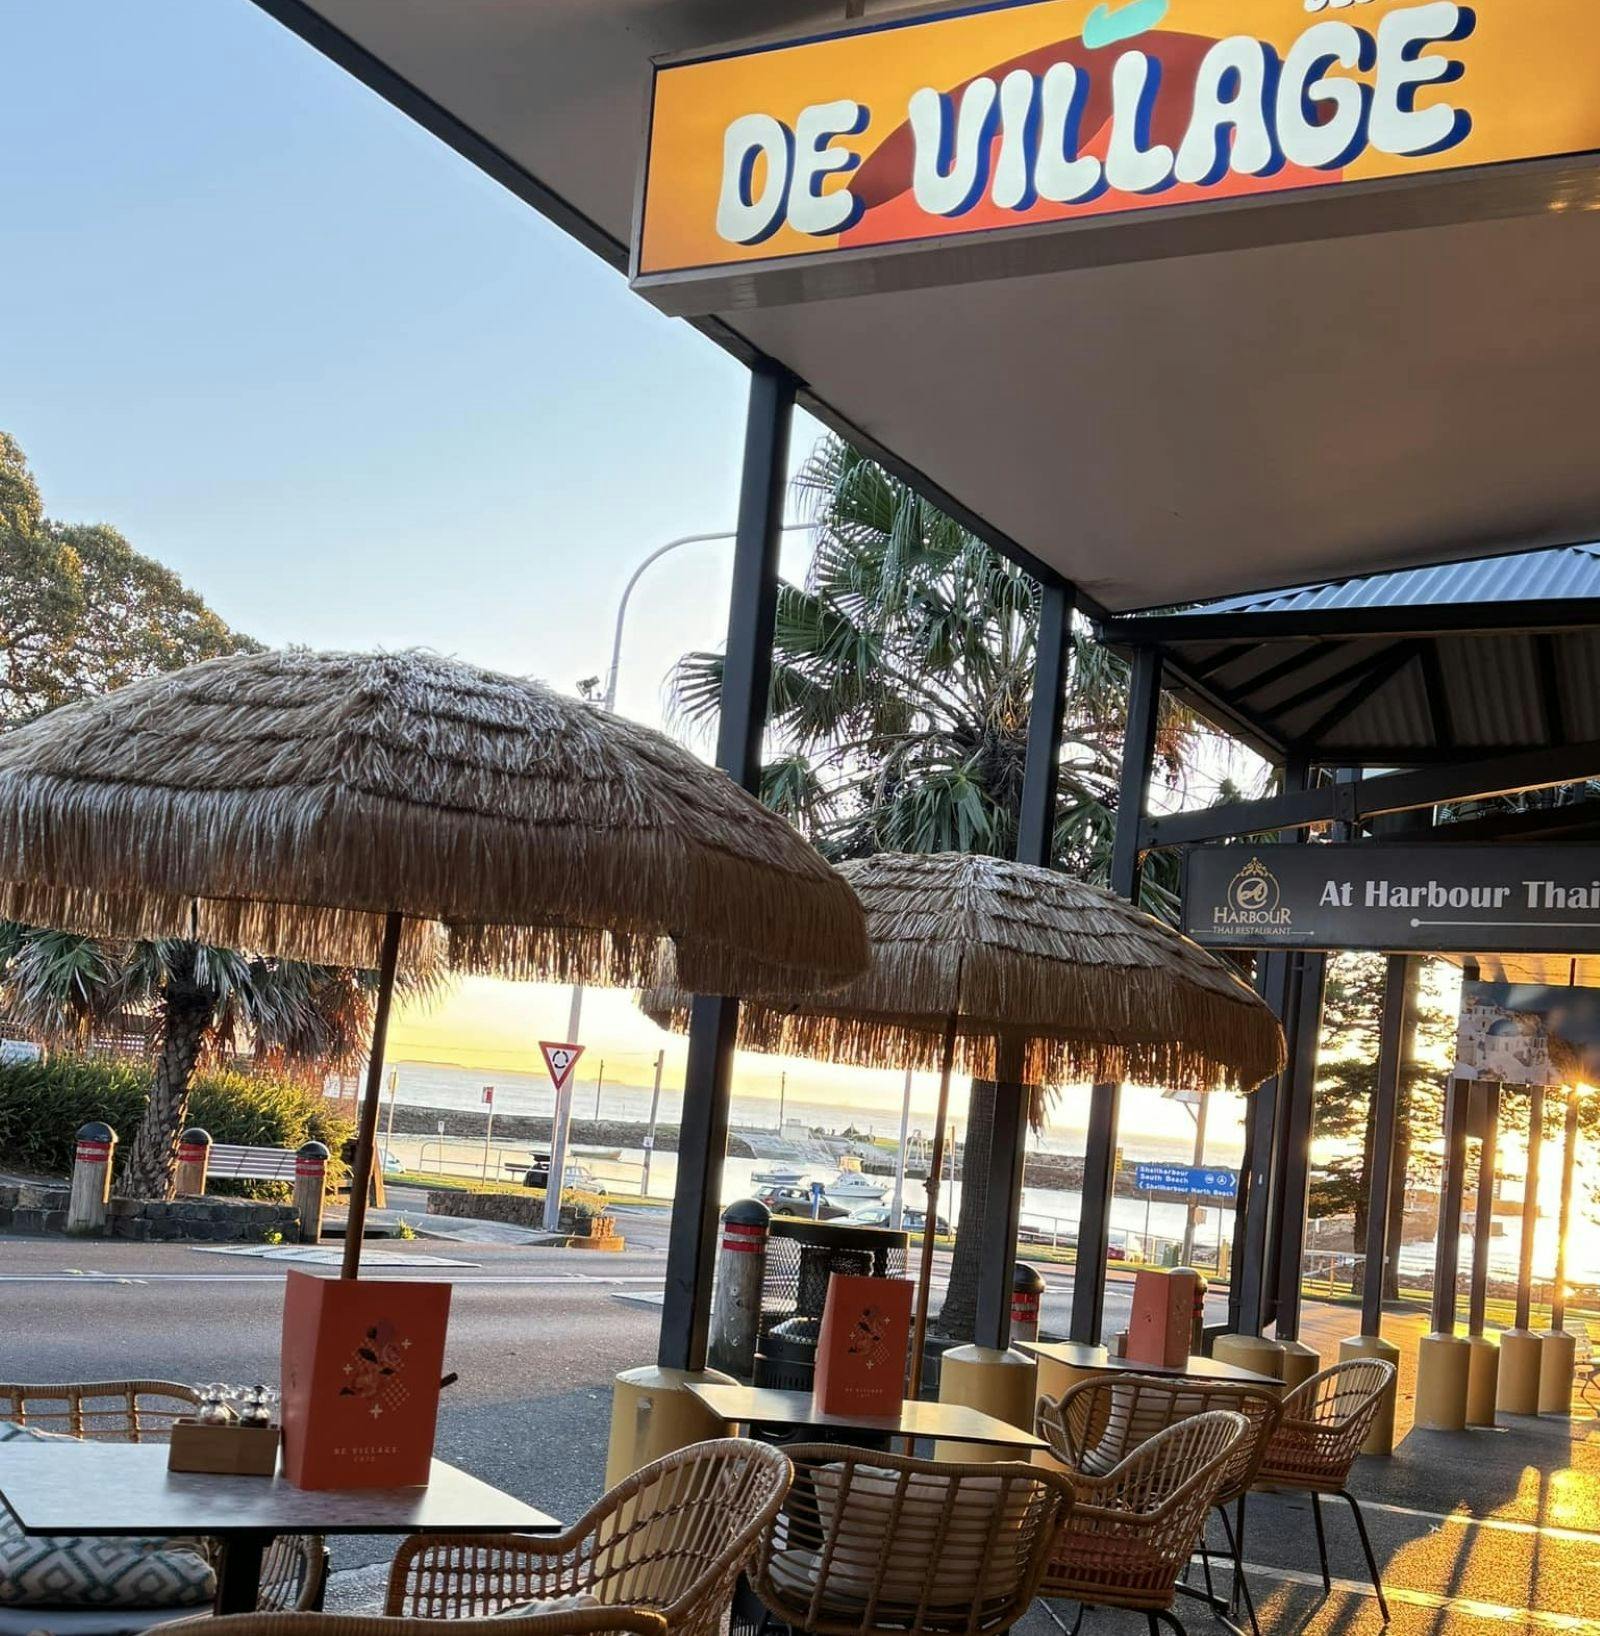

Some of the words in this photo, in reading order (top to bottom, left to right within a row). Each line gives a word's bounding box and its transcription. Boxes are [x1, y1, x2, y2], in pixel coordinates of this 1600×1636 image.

[716, 99, 870, 246] DE
[908, 1, 1473, 218] VILLAGE
[1319, 880, 1354, 907] At
[1364, 880, 1510, 908] Harbour
[1522, 880, 1600, 909] Thai
[1213, 926, 1234, 935] THAI
[1235, 926, 1292, 936] RESTAURANT
[1140, 1173, 1163, 1181] South
[1165, 1175, 1189, 1184] Beach
